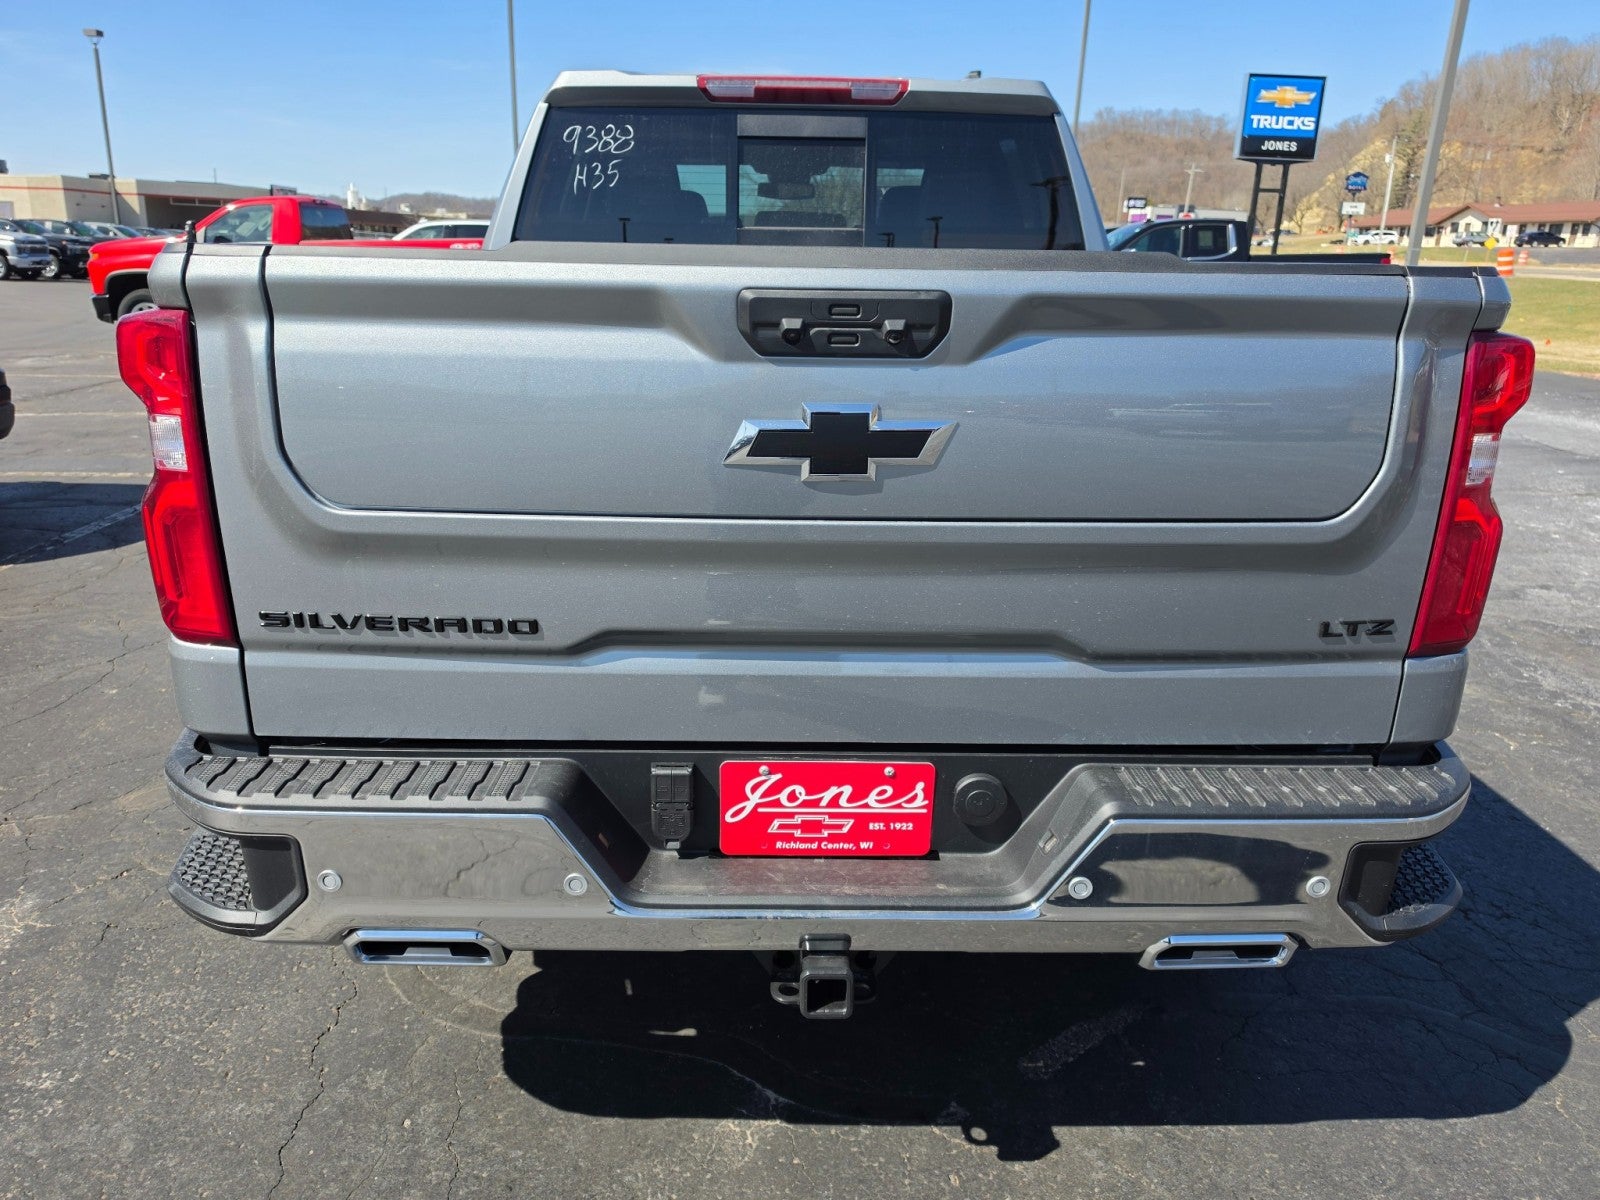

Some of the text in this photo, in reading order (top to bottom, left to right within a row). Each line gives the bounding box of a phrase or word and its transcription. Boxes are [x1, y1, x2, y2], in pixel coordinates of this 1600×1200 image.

[1250, 114, 1316, 130] TRUCKS
[563, 124, 634, 154] 9388
[1261, 140, 1297, 151] JONES
[574, 159, 622, 195] H35
[259, 611, 539, 635] SILVERADO
[1319, 619, 1395, 637] LTZ
[725, 773, 929, 823] Jones
[868, 822, 913, 830] EST. 1922
[775, 841, 874, 850] Richland Center, WI
